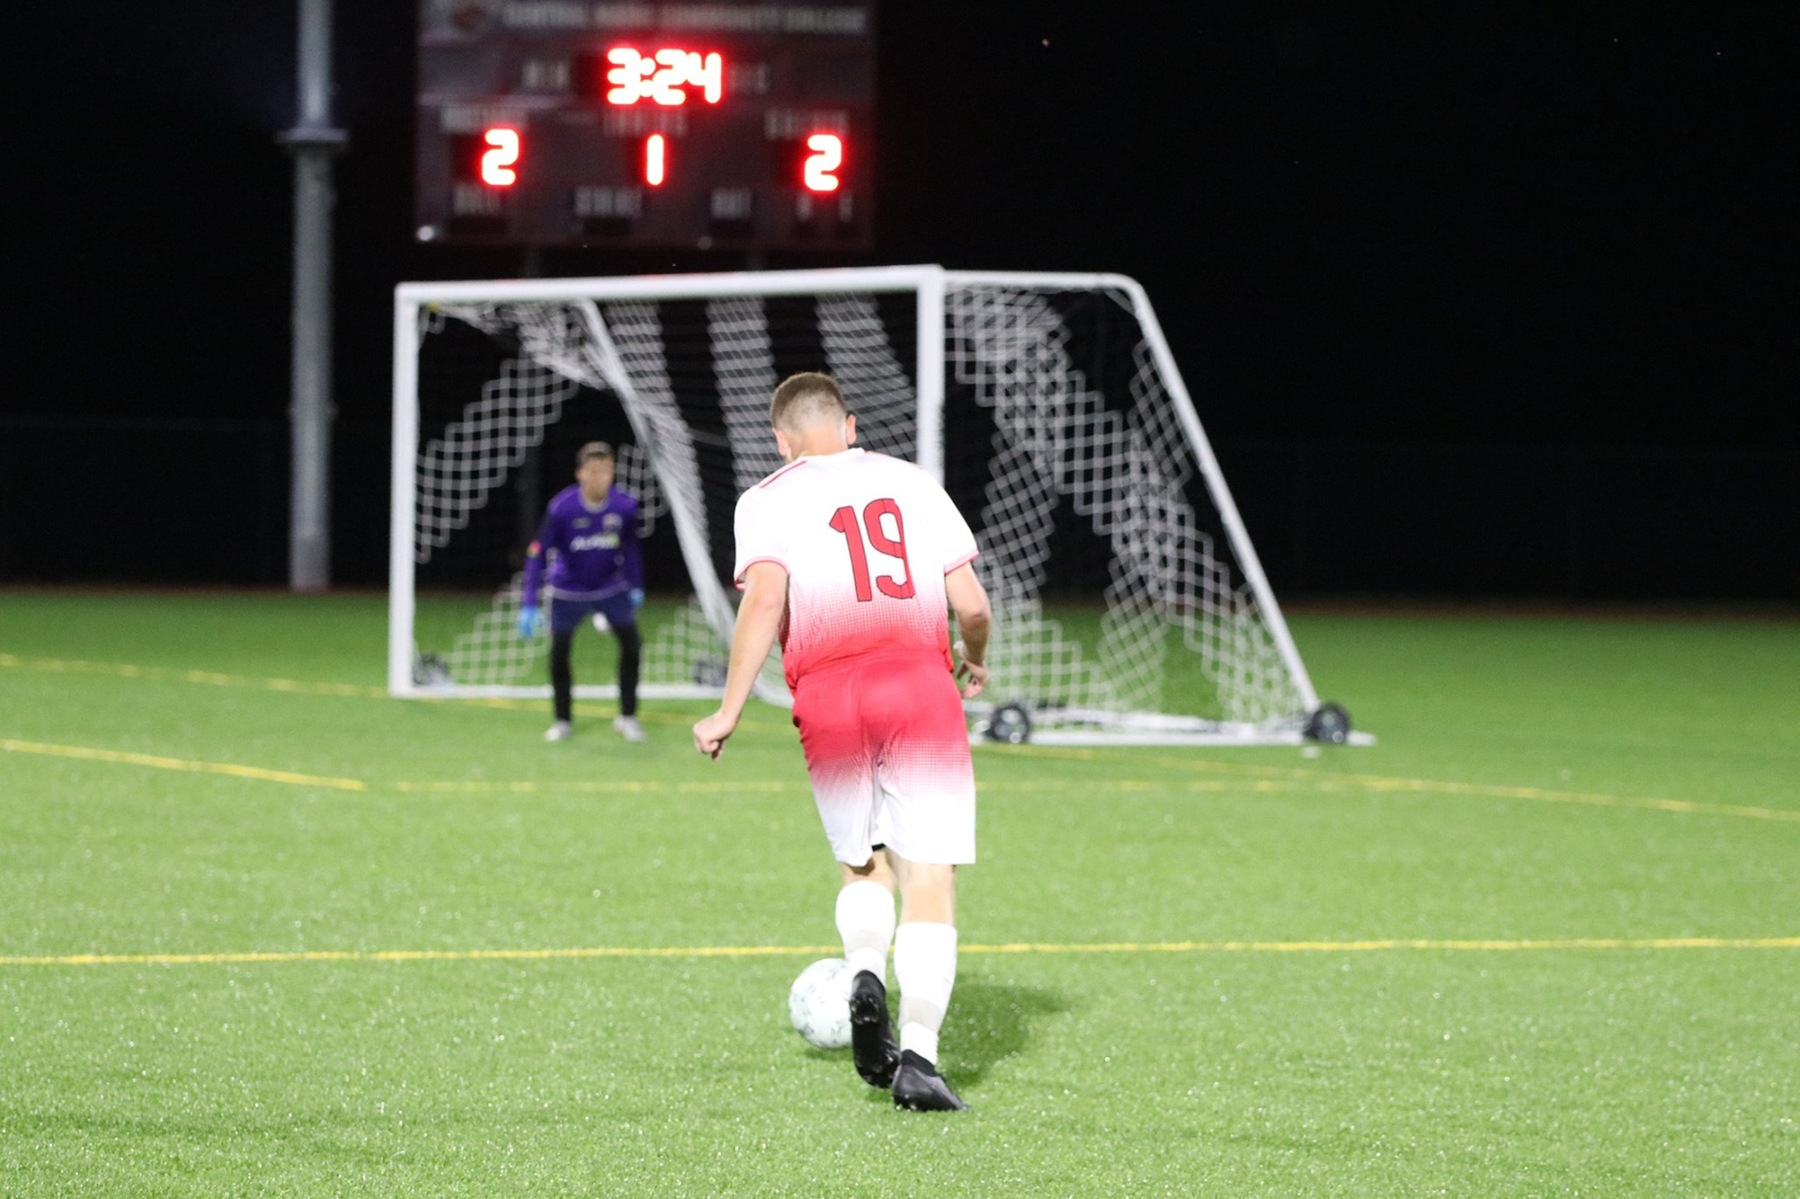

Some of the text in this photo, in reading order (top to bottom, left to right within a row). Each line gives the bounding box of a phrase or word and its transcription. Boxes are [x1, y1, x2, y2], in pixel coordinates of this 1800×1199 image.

[607, 48, 722, 105] 3:24
[482, 129, 519, 186] 2
[646, 134, 664, 186] 1
[804, 134, 842, 191] 2
[829, 498, 915, 602] 19
